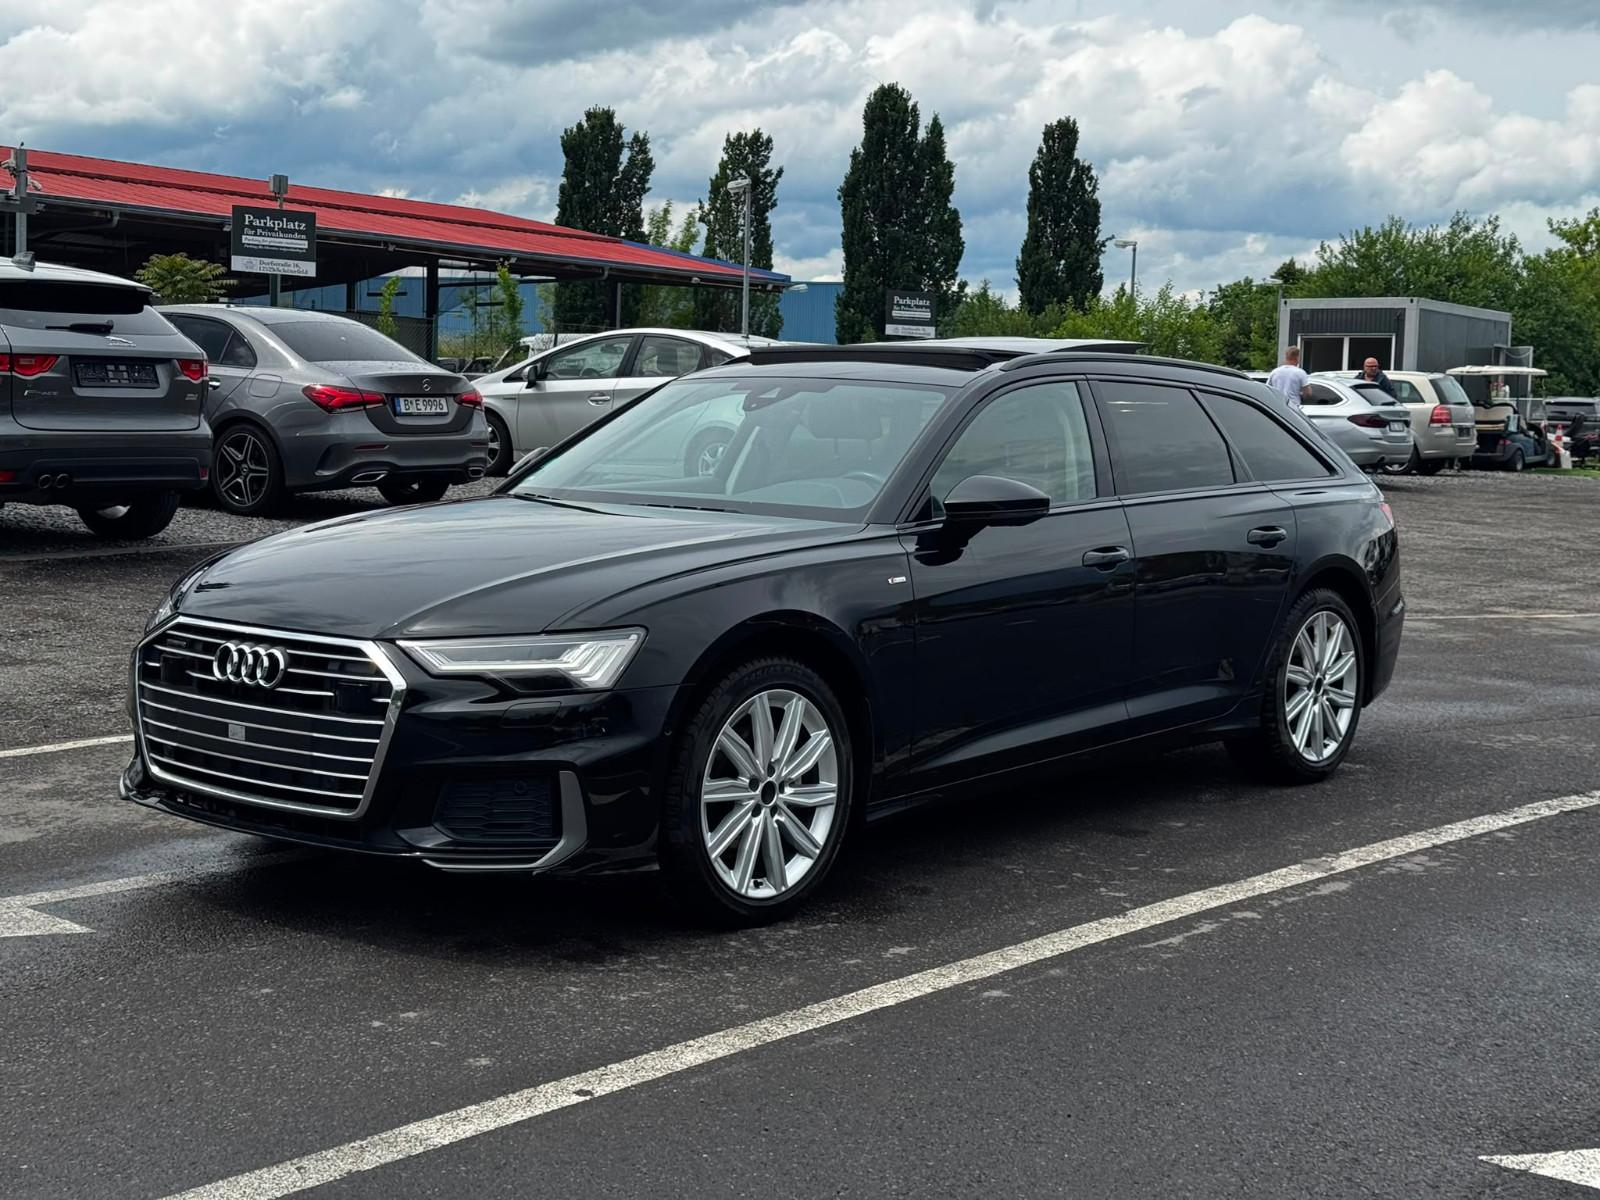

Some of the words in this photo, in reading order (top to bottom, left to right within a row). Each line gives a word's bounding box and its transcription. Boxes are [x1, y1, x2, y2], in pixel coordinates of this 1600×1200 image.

[244, 214, 306, 231] Parkplatz
[257, 229, 306, 239] Privatkunden
[893, 296, 930, 307] Parkplatz
[404, 399, 410, 411] B
[415, 399, 422, 411] E
[422, 399, 444, 411] 9996
